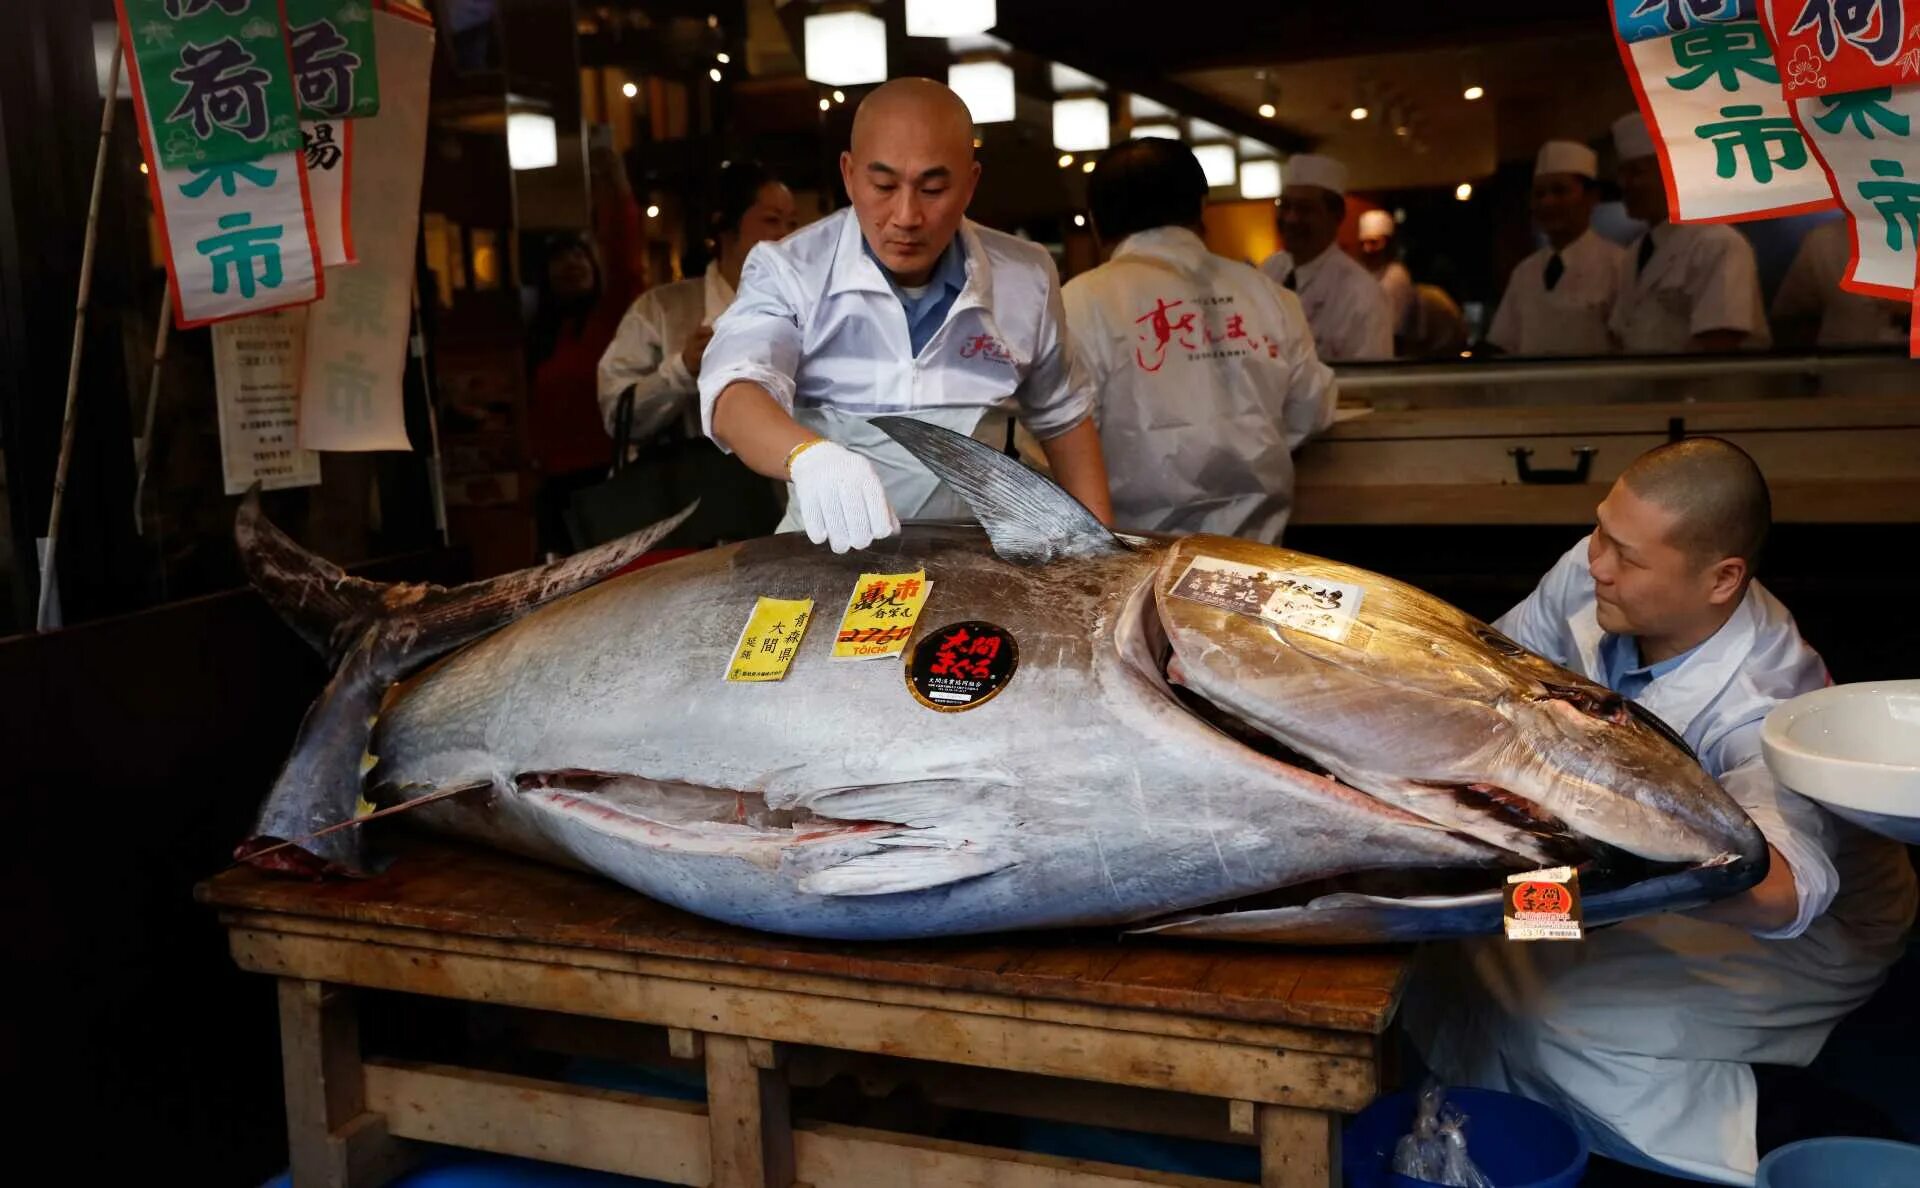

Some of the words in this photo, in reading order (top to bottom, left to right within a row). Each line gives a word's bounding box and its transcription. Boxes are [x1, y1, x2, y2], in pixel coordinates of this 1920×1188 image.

[760, 621, 786, 653] 大間
[777, 612, 808, 662] 青森県
